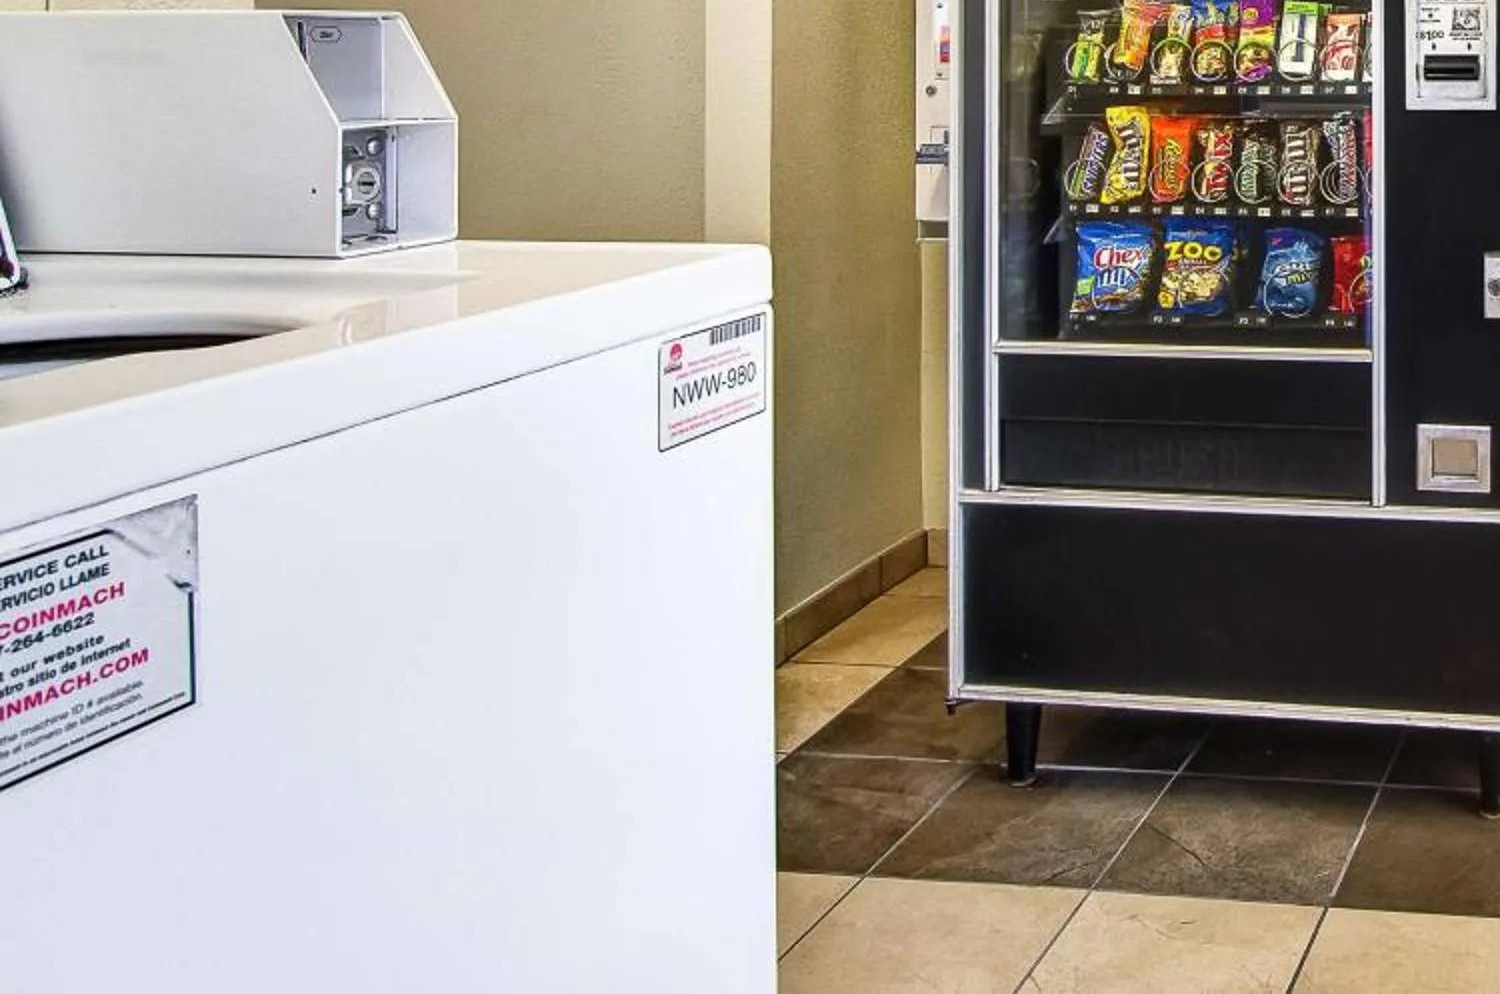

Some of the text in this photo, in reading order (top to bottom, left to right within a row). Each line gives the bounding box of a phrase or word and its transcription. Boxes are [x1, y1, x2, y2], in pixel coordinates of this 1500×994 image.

[1164, 241, 1223, 261] ZOO
[673, 361, 757, 409] NWW-980
[0, 545, 109, 591] RVICE CALL
[0, 562, 111, 612] RVICIO LLAME
[10, 660, 38, 678] our
[43, 635, 105, 665] website
[28, 668, 57, 687] sitio
[61, 660, 78, 674] de
[80, 638, 132, 666] internet
